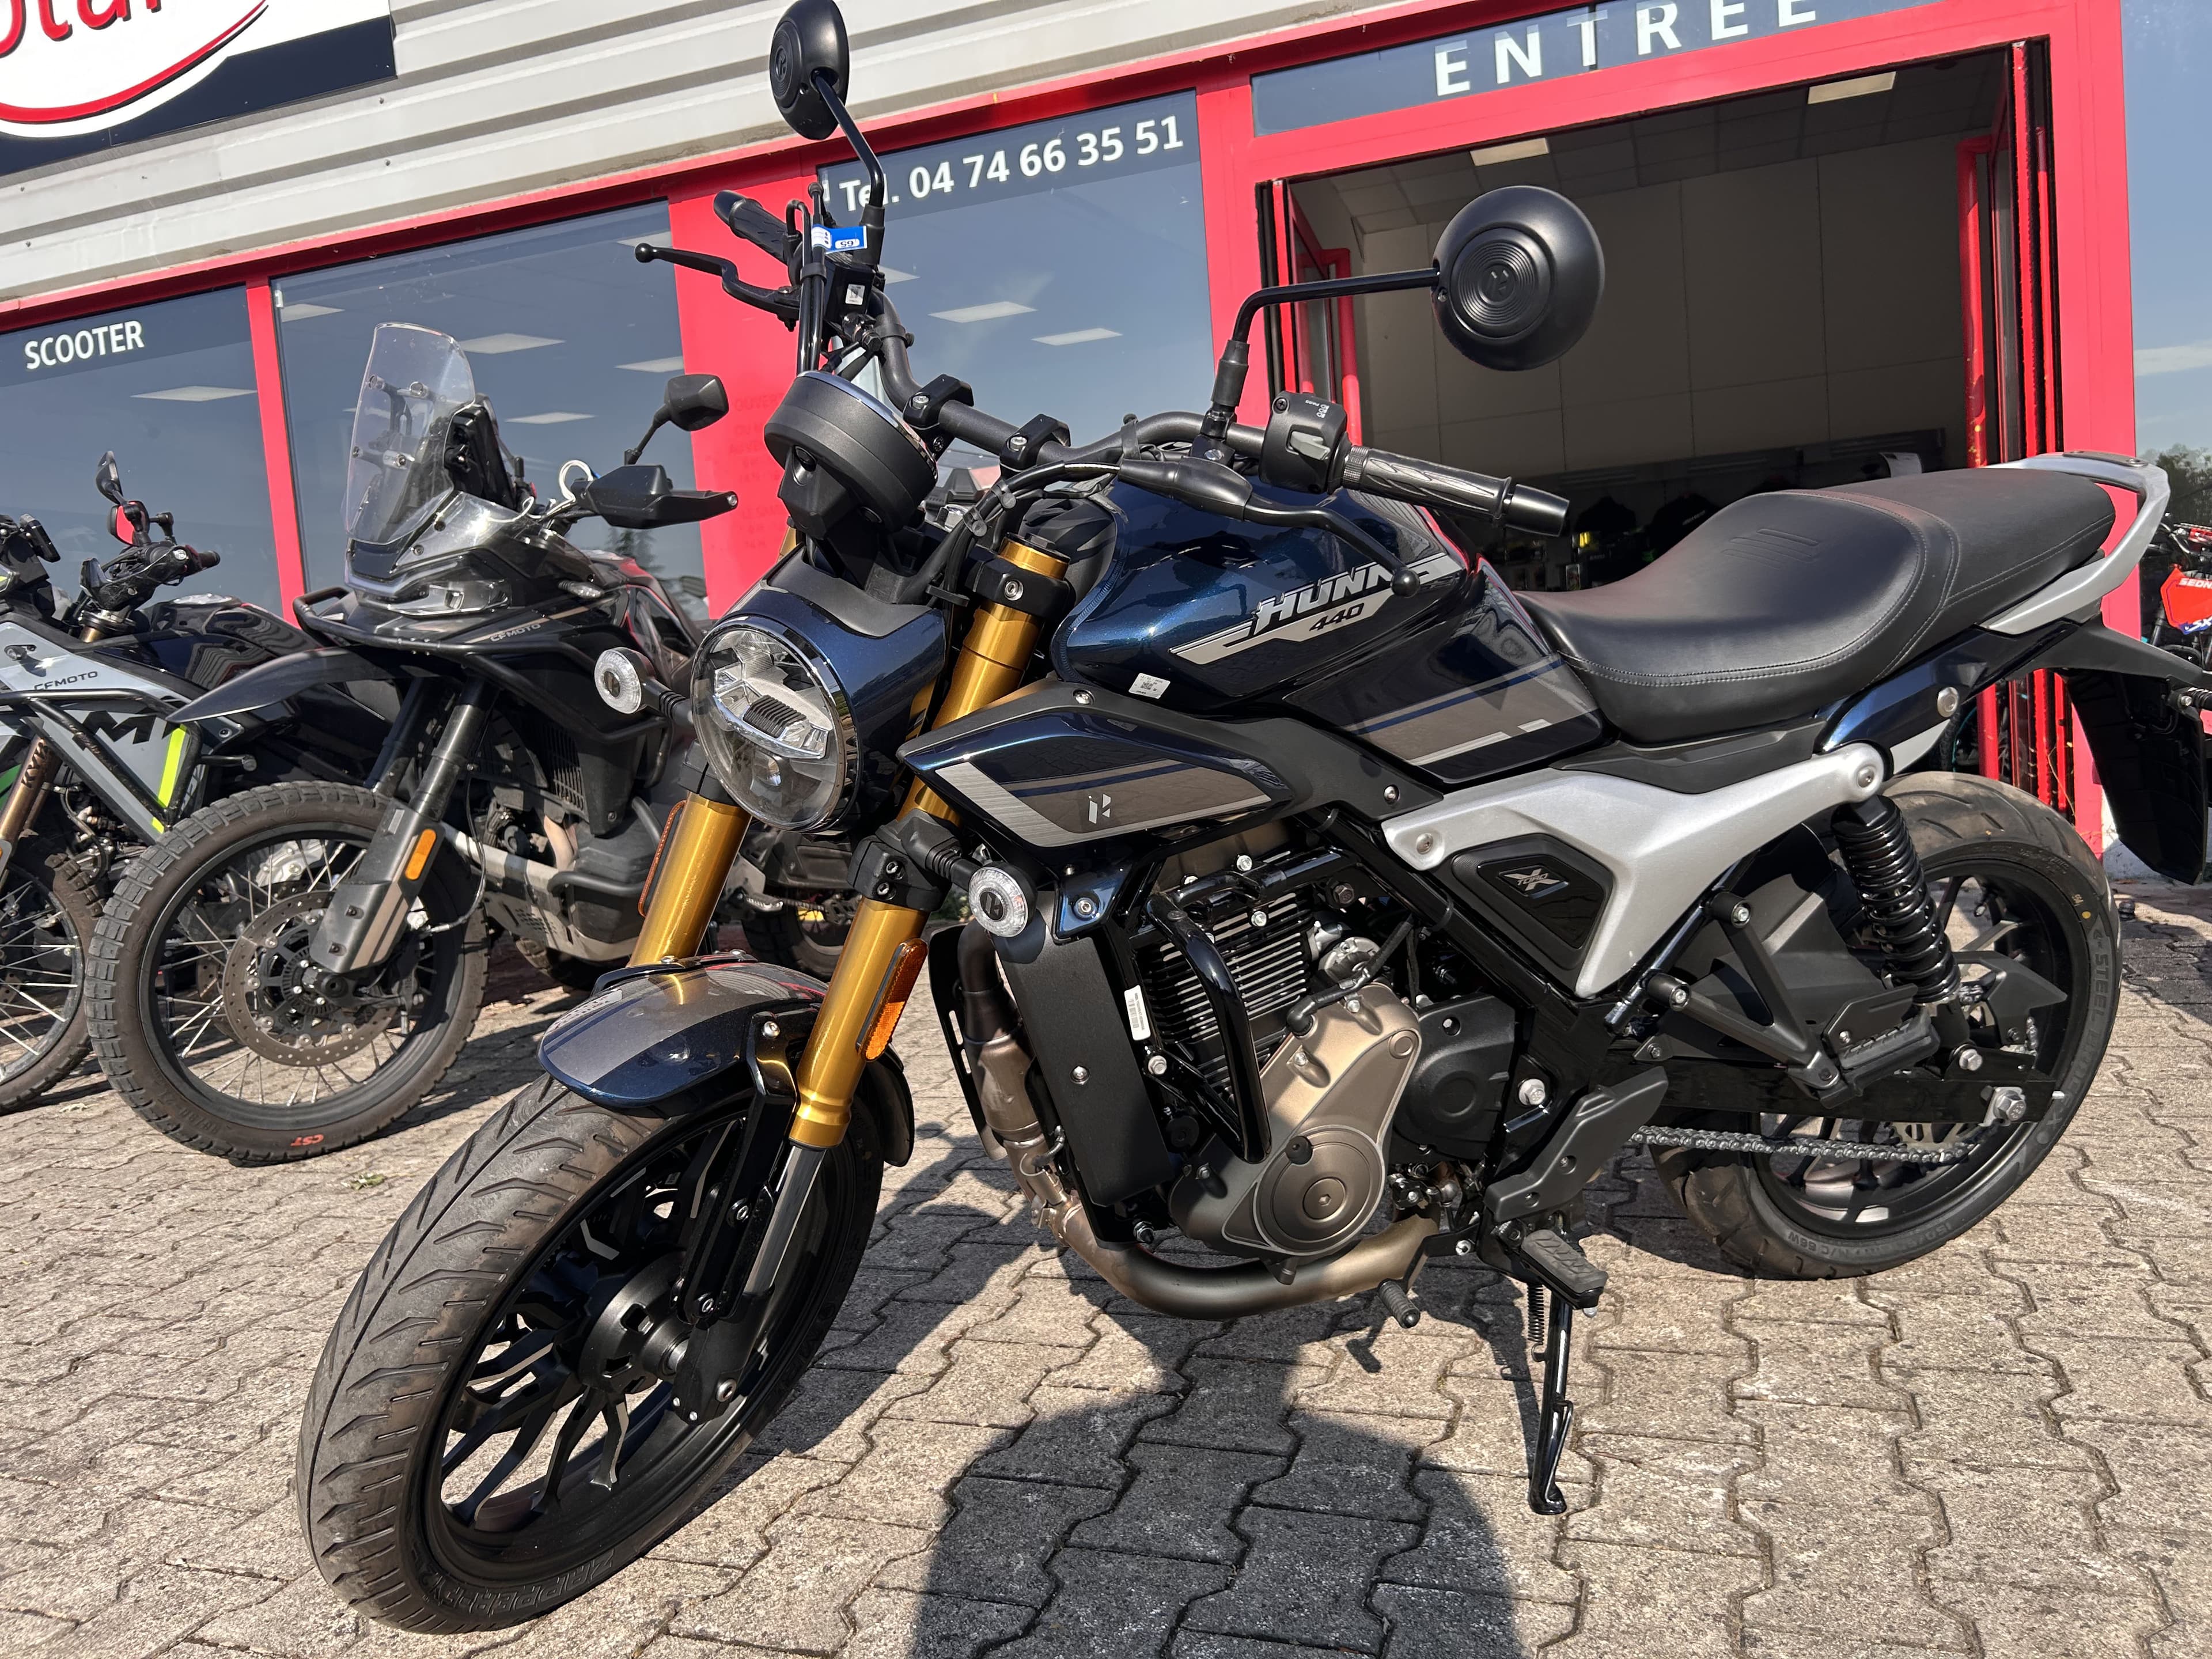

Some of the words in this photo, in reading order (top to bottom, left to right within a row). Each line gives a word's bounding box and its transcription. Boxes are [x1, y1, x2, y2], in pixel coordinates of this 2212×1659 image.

[909, 162, 955, 199] 04
[963, 150, 1010, 188] 74
[1020, 139, 1066, 176] 66
[1076, 127, 1124, 166] 35
[1135, 115, 1184, 154] 51
[25, 320, 145, 369] SCOOTER
[1309, 603, 1365, 632] 440
[490, 623, 541, 642] CFMOTO
[33, 671, 98, 691] CFMOTO
[290, 1134, 324, 1146] CST
